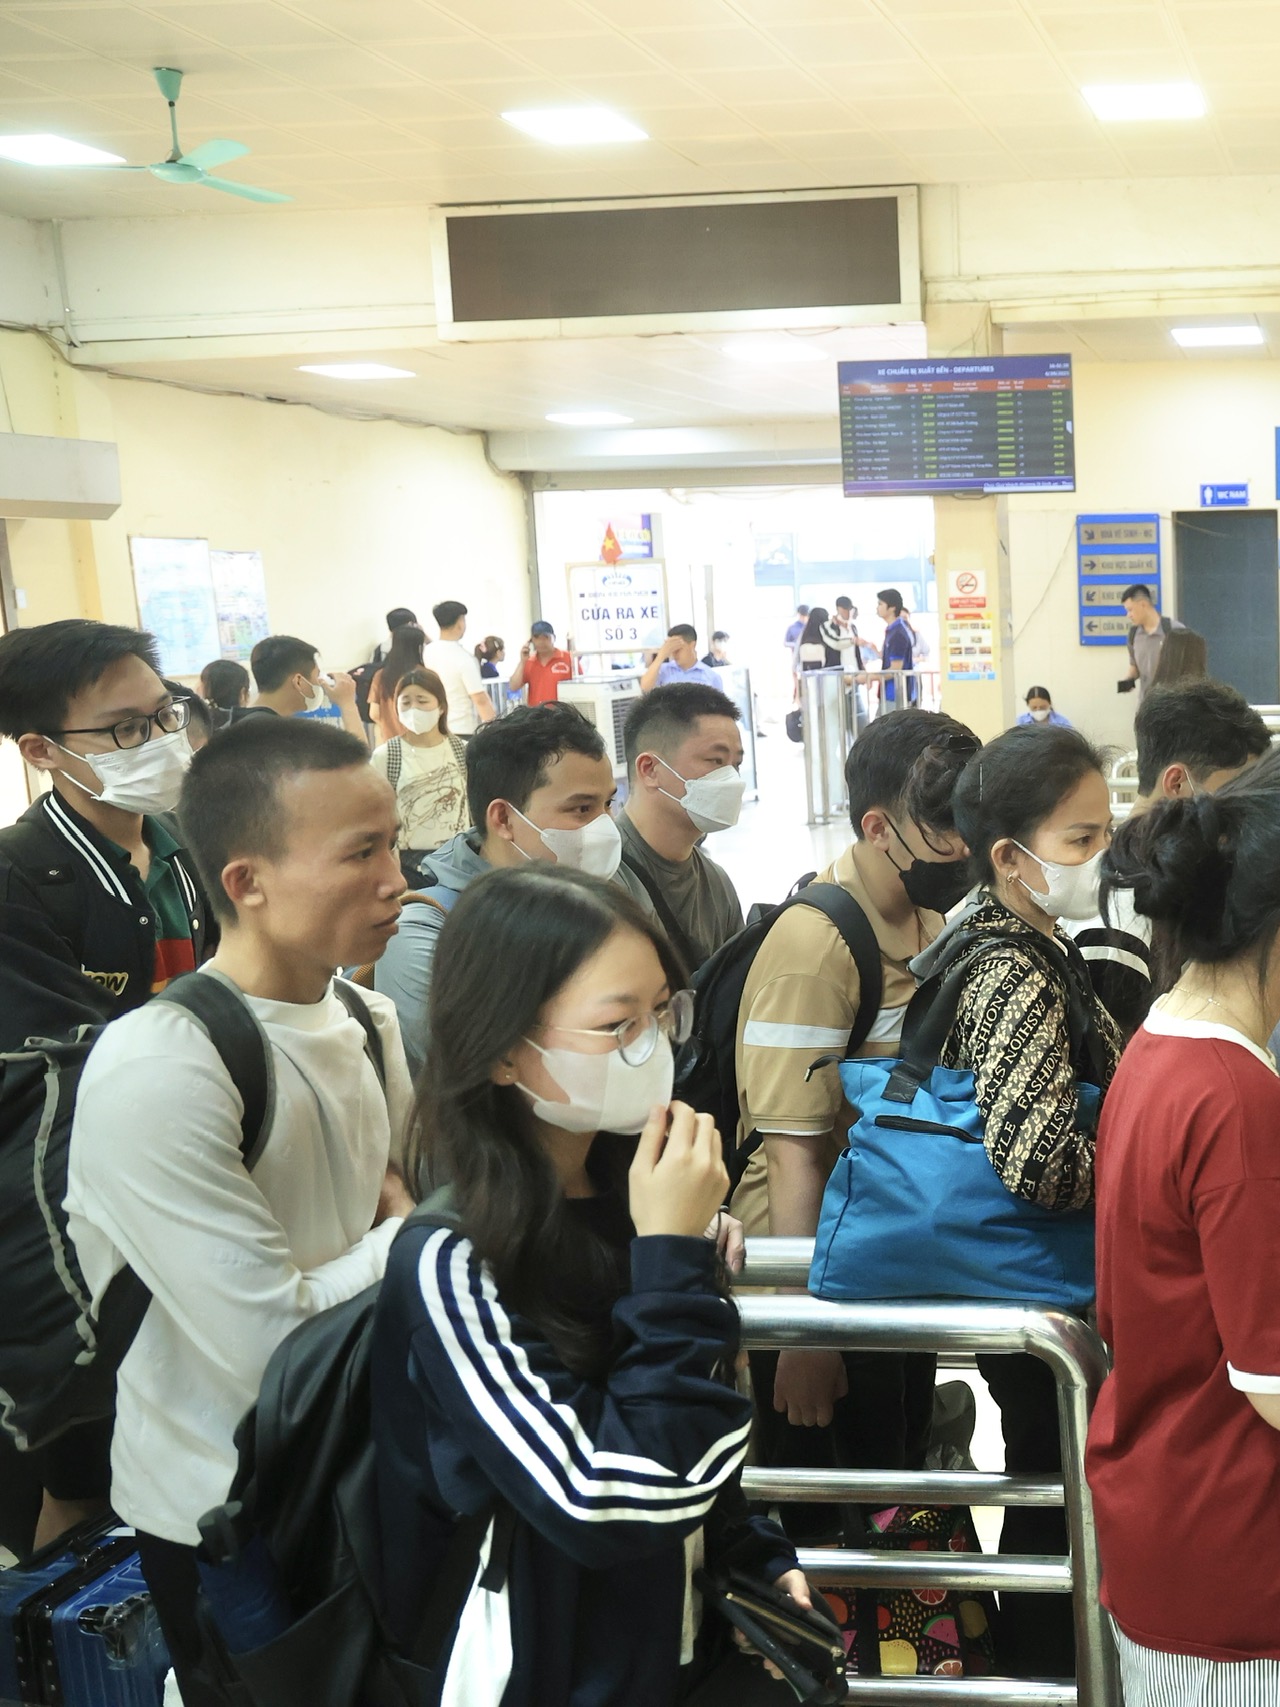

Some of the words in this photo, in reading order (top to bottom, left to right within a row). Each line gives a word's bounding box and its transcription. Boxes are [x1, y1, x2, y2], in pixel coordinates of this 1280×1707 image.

[581, 603, 611, 621] CỬA
[616, 607, 635, 620] RA
[640, 606, 659, 619] XE
[629, 627, 638, 640] 3
[1004, 998, 1046, 1065] FASHION
[1017, 1048, 1062, 1110] FASHION
[994, 1121, 1016, 1175] TYLE
[1032, 1111, 1066, 1163] STYLE
